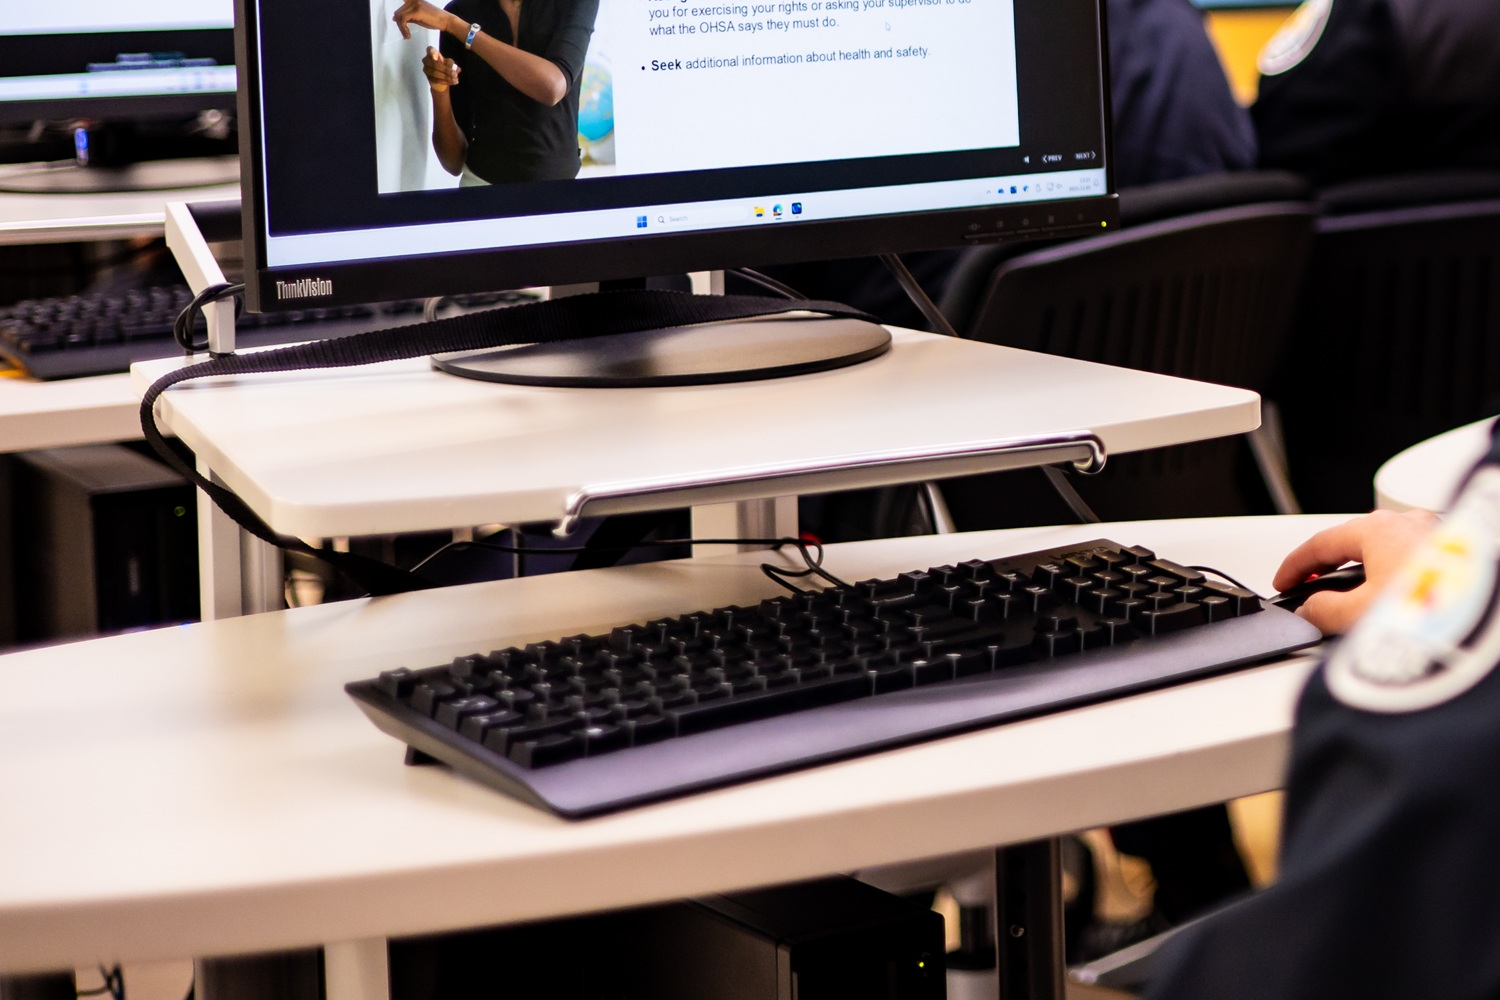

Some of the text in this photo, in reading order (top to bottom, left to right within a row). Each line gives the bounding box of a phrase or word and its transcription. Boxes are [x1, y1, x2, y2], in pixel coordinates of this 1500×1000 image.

[648, 8, 670, 21] you
[672, 5, 688, 18] for
[691, 3, 748, 19] exercising
[751, 2, 776, 16] your
[778, 0, 808, 15] rights
[810, 1, 823, 11] or
[649, 16, 840, 36] what the OHSA says they must do.
[651, 45, 930, 71] Seek additional information about health and safety.
[1048, 154, 1062, 162] PREV
[1075, 152, 1090, 160] NEXT
[669, 215, 688, 223] Search
[276, 277, 333, 300] ThinkVision
